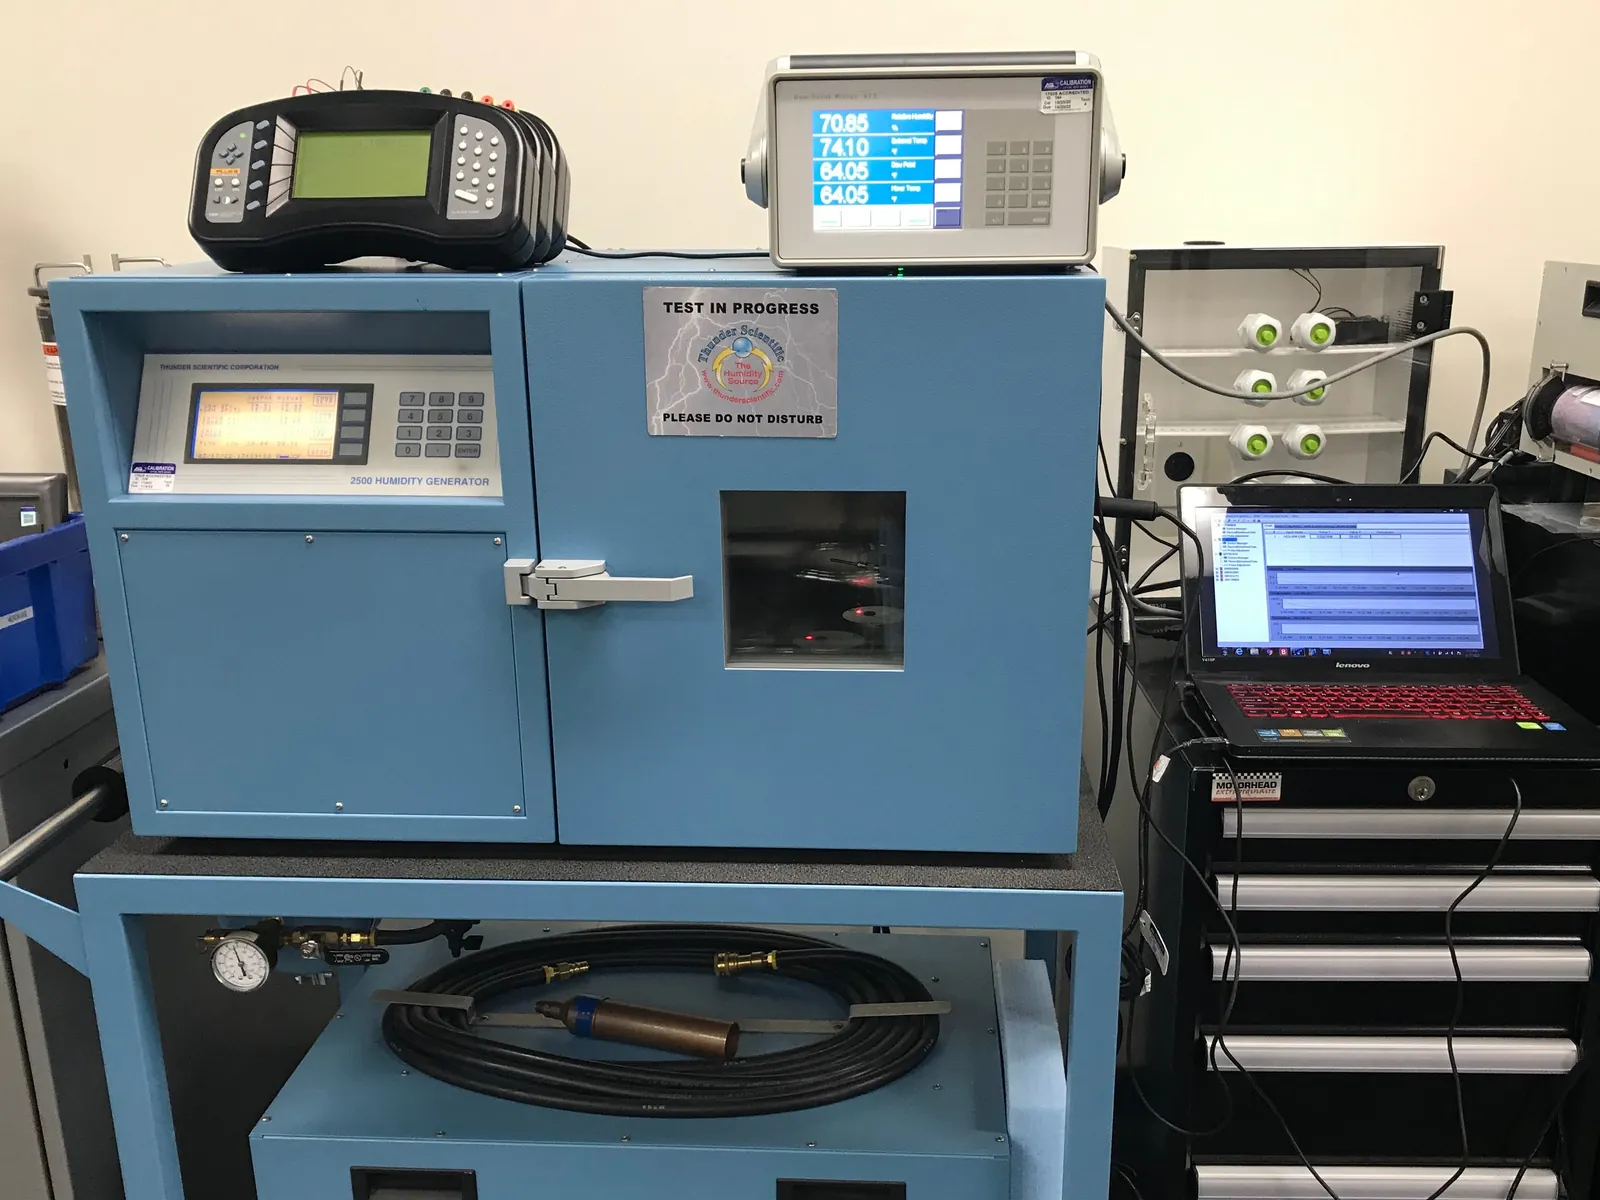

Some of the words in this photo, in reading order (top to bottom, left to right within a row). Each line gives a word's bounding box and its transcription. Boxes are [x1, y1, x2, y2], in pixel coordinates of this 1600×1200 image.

[819, 113, 869, 133] 70.85
[819, 137, 869, 157] 74.10
[819, 161, 869, 181] 64.05
[819, 185, 869, 204] 64.05
[663, 302, 704, 314] TEST
[710, 302, 727, 314] IN
[732, 302, 819, 315] PROGRESS
[698, 326, 738, 364] Thunder
[740, 324, 785, 363] Scientific
[735, 361, 751, 370] The
[723, 370, 763, 379] Humidity
[727, 378, 759, 386] Source
[701, 369, 785, 405] www.thunderscientific.com
[409, 395, 415, 403] 7
[438, 395, 444, 403] 8
[468, 395, 474, 403] 9
[408, 412, 413, 420] 4
[467, 413, 473, 421] 6
[662, 413, 711, 423] PLEASE
[715, 413, 733, 423] DO
[737, 414, 763, 424] NOT
[767, 414, 823, 424] DISTURB
[436, 430, 442, 438] 2
[466, 430, 472, 438] 3
[405, 446, 411, 454] 0
[350, 476, 373, 485] 2500
[375, 477, 423, 485] HUMIDITY
[426, 477, 490, 486] GENERATOR
[1335, 661, 1370, 669] lenovo
[1216, 781, 1277, 789] MOORHEAD
